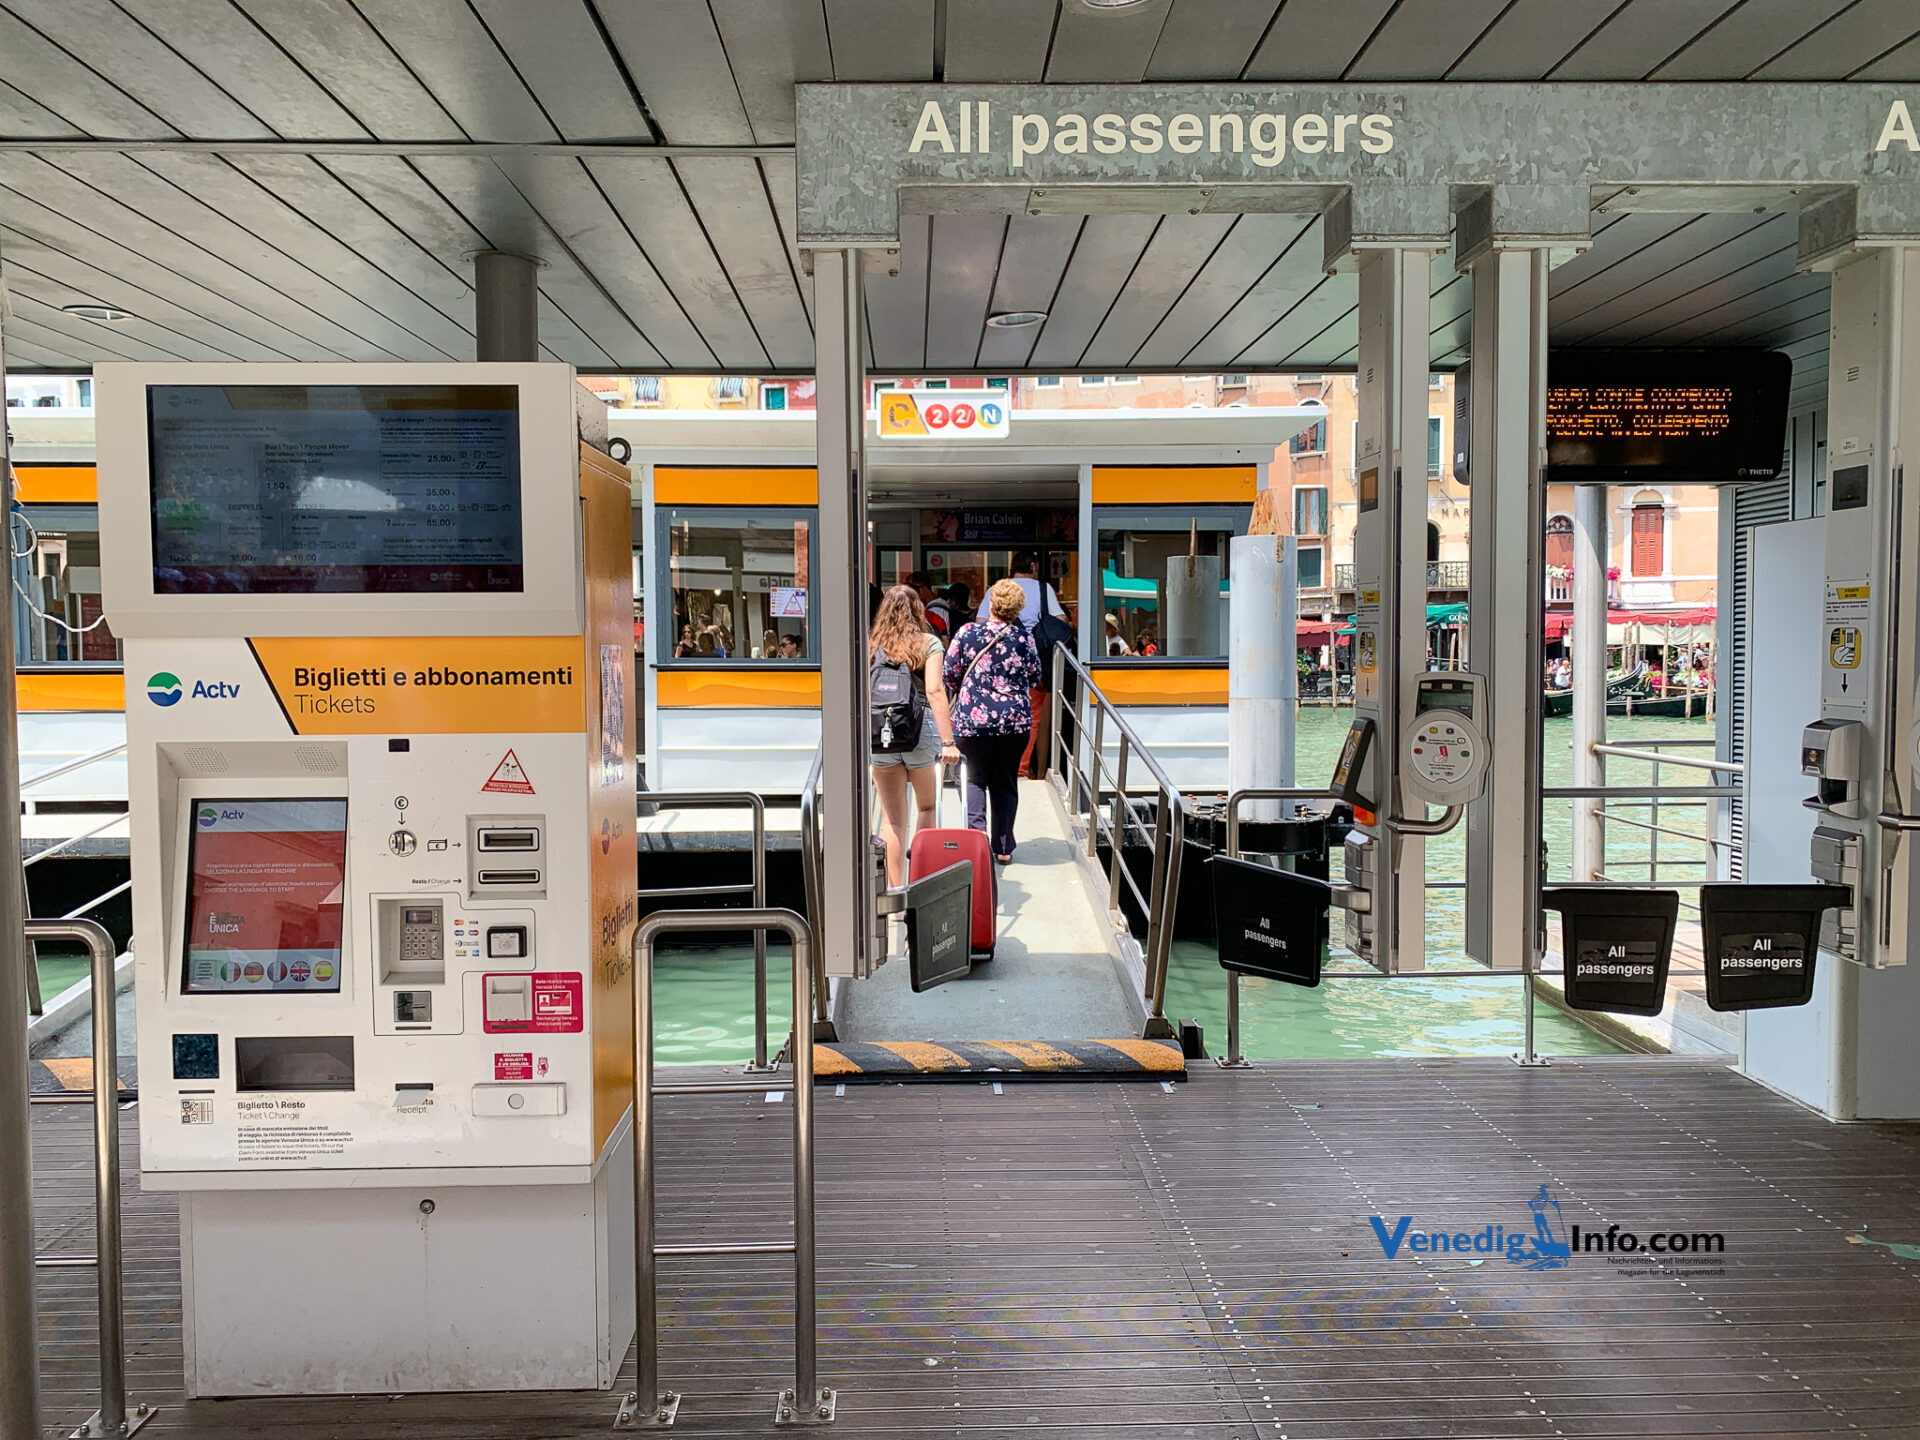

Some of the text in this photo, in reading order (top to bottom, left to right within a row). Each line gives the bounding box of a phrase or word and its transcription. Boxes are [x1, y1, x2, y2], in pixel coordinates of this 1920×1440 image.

[908, 99, 1395, 168] All passengers
[932, 408, 942, 424] 2
[983, 408, 997, 423] N
[963, 513, 1023, 525] Brian Calvin
[294, 666, 573, 692] Biglietti e abbonamenti
[191, 680, 241, 699] Actv
[294, 694, 376, 714] Tickets
[220, 809, 245, 821] Actv
[602, 894, 634, 947] Biglietti
[1260, 916, 1271, 930] All
[209, 923, 240, 933] UNICA
[1244, 928, 1287, 950] passengers
[1752, 938, 1772, 951] All
[1607, 945, 1626, 958] All
[1576, 963, 1654, 978] passengers
[1720, 957, 1803, 971] passengers
[237, 1101, 274, 1111] Biglietto
[281, 1101, 306, 1109] Resto
[396, 1105, 428, 1115] Receipt
[238, 1111, 262, 1120] Ticket
[268, 1111, 300, 1121] Change
